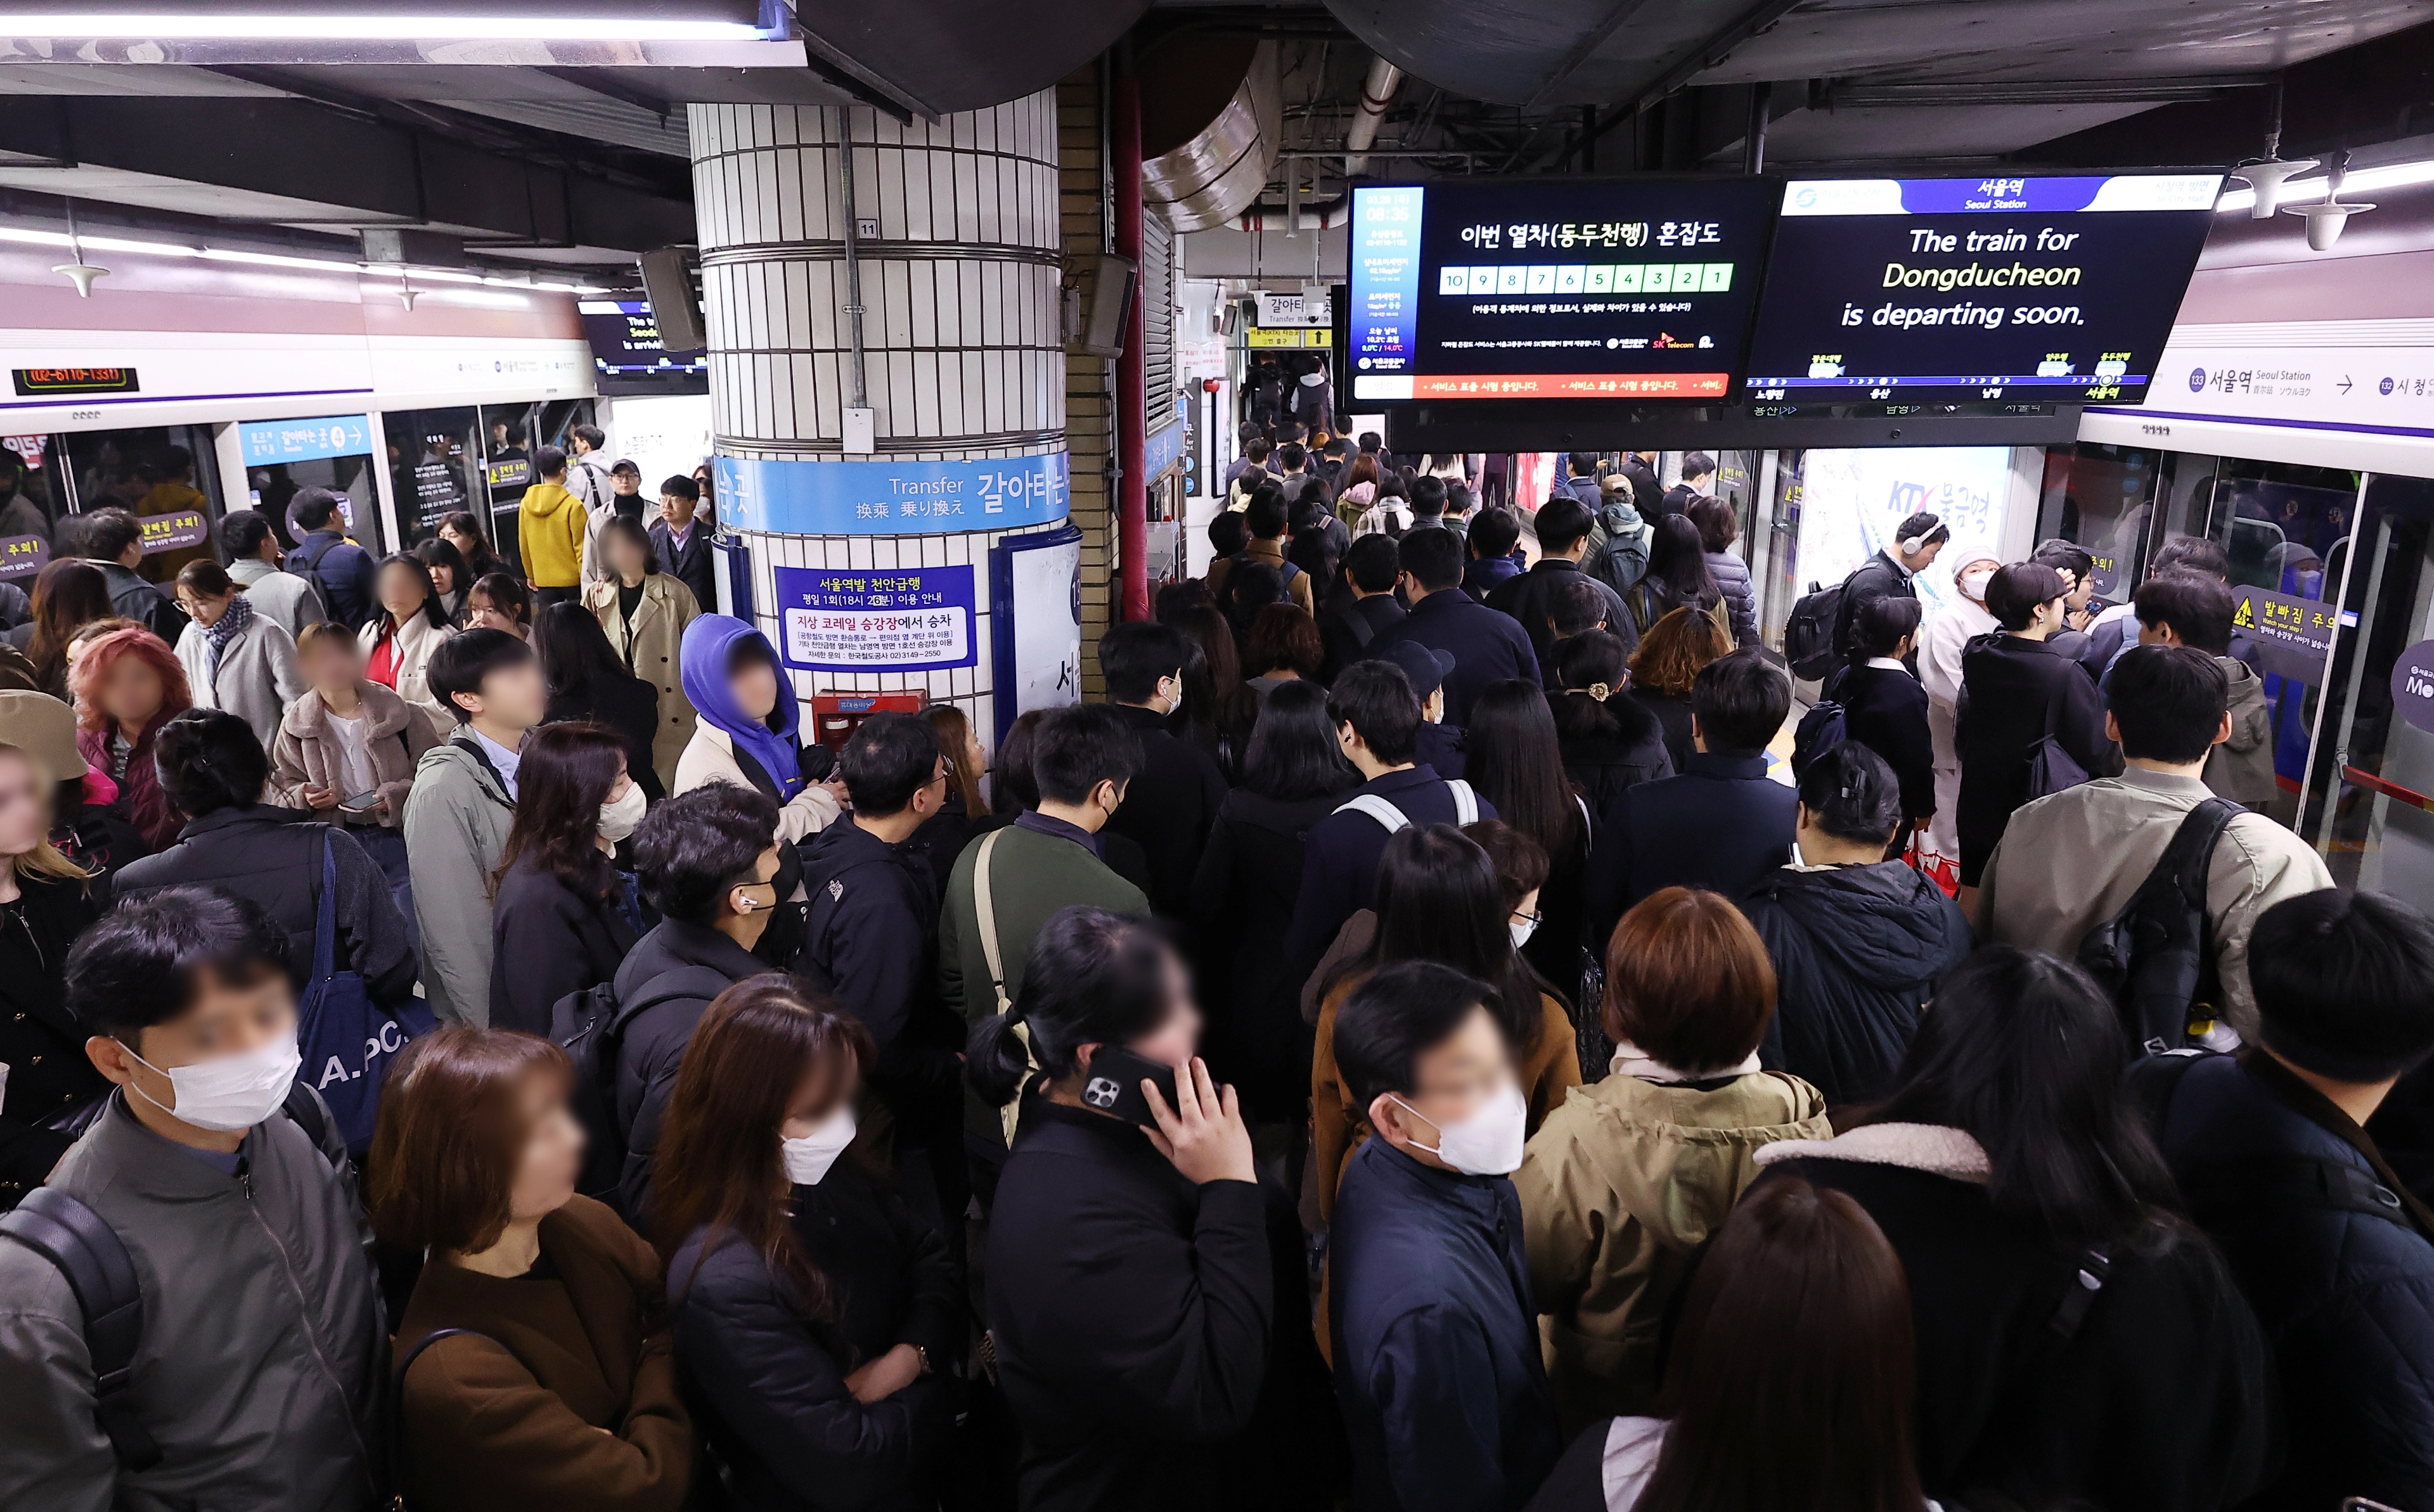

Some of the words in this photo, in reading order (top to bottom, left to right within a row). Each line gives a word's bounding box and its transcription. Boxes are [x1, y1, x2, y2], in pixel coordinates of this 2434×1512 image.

[1977, 179, 2025, 197] 서울역
[2155, 180, 2184, 193] 시청역
[2188, 180, 2210, 192] 방면
[1964, 199, 1994, 210] Seoul
[1996, 198, 2027, 210] Station
[2168, 195, 2184, 204] City
[1366, 207, 1410, 222] 08:35
[861, 224, 874, 234] 11
[1461, 224, 1501, 249] 이번
[1508, 222, 1649, 248] 열차(동두천행)
[1656, 221, 1722, 247] 혼잡도
[1910, 229, 1956, 252] The
[1967, 229, 2028, 252] train
[2037, 227, 2078, 252] for
[1363, 257, 1409, 267] 실내초미세먼지
[1446, 275, 1463, 287] 10
[1479, 275, 1487, 286] 9
[1508, 275, 1516, 286] 8
[1538, 274, 1545, 286] 7
[1566, 274, 1574, 286] 6
[1595, 274, 1603, 285] 5
[1624, 274, 1632, 285] 4
[1654, 273, 1662, 285] 3
[1683, 272, 1691, 284] 2
[1715, 272, 1720, 283] 1
[1882, 262, 2081, 292] Dongducheon
[1368, 292, 1401, 301] 초미세먼지
[1472, 304, 1498, 314] (이용객
[1499, 304, 1529, 314] 통계치에
[1531, 304, 1547, 314] 의한
[1582, 304, 1606, 313] 실제와
[1607, 303, 1630, 312] 차이가
[1632, 303, 1647, 312] 있을
[1648, 303, 1657, 312] 수
[1658, 302, 1692, 312] 있습니다)
[626, 316, 645, 326] The
[1841, 304, 1863, 326] is
[1872, 302, 2005, 330] departing
[2011, 305, 2085, 326] soon.
[1368, 327, 1383, 335] 오늘
[1384, 327, 1398, 335] 날씨
[1652, 340, 1665, 349] SK
[1811, 354, 1842, 363] 광운대행
[2045, 352, 2069, 361] 양주행
[2100, 352, 2131, 361] 동두천행
[1430, 381, 1457, 392] 서비스
[1459, 381, 1479, 392] 표출
[1481, 381, 1498, 392] 시험
[1501, 381, 1539, 392] 중입니다.
[1568, 381, 1595, 391] 서비스
[1598, 381, 1617, 391] 표출
[1619, 381, 1638, 391] 시험
[1640, 380, 1678, 391] 중입니다.
[2191, 375, 2205, 387] 133
[2210, 369, 2252, 394] 서울역
[2256, 370, 2279, 380] Seoul
[2281, 371, 2311, 381] Station
[2380, 382, 2393, 391] 132
[1755, 388, 1785, 400] 노량진
[1870, 388, 1891, 399] 용산
[1981, 387, 2004, 399] 남영
[2085, 386, 2120, 399] 서울역
[2253, 385, 2274, 395] 首尔站
[2279, 386, 2311, 397] ソウルヨク
[734, 473, 750, 515] 곳
[889, 475, 964, 495] Transfer
[977, 468, 1063, 514] 갈아타는
[900, 499, 965, 517] 乗り換え
[820, 577, 866, 593] 서울역발
[871, 576, 920, 592] 천안급행
[802, 594, 820, 606] 평일
[823, 594, 863, 606] 1회(18시
[866, 594, 894, 606] 26분)
[898, 593, 918, 606] 이용
[921, 591, 942, 605] 안내
[2264, 599, 2304, 625] 발빠짐
[797, 615, 818, 630] 지상
[821, 617, 856, 631] 코레일
[860, 615, 923, 631] 승강장에서
[927, 613, 952, 629] 승차
[2262, 617, 2277, 627] Watch
[2277, 622, 2289, 631] your
[2289, 624, 2300, 634] step
[797, 631, 824, 641] [공항철도
[840, 634, 867, 642] 환승통로
[936, 630, 953, 638] 이용]
[2260, 624, 2276, 637] 열차와
[2276, 629, 2293, 642] 승강장
[2293, 634, 2310, 646] 사이가
[811, 641, 835, 650] 천안급행
[837, 642, 858, 650] 열차는
[917, 639, 938, 648] 승강장
[808, 650, 826, 658] 자세한
[848, 651, 888, 660] 한국철도공사
[2418, 669, 2434, 679] 서울교
